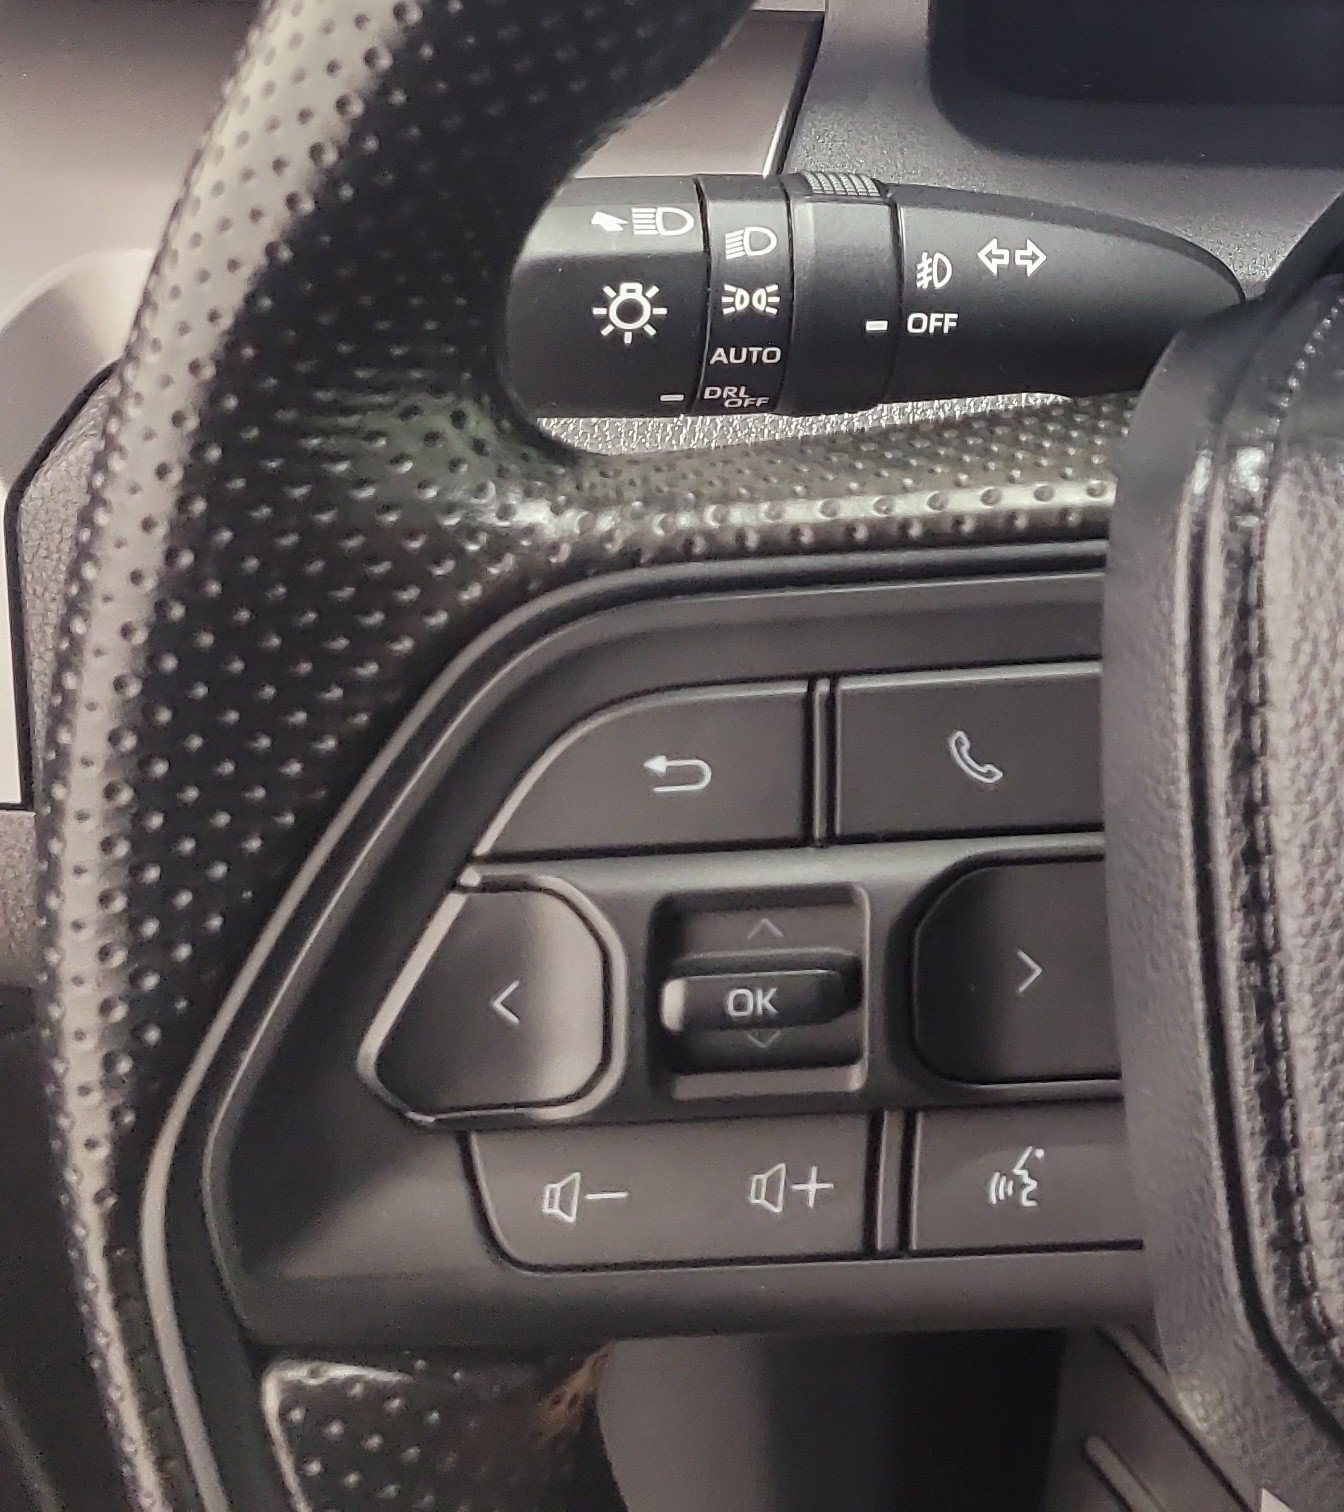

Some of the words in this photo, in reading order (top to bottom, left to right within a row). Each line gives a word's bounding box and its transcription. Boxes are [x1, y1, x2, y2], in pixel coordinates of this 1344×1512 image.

[906, 312, 959, 334] OFF
[708, 346, 782, 365] AUTO
[703, 385, 750, 399] DRL
[722, 395, 770, 409] OFF
[725, 987, 779, 1018] OK
